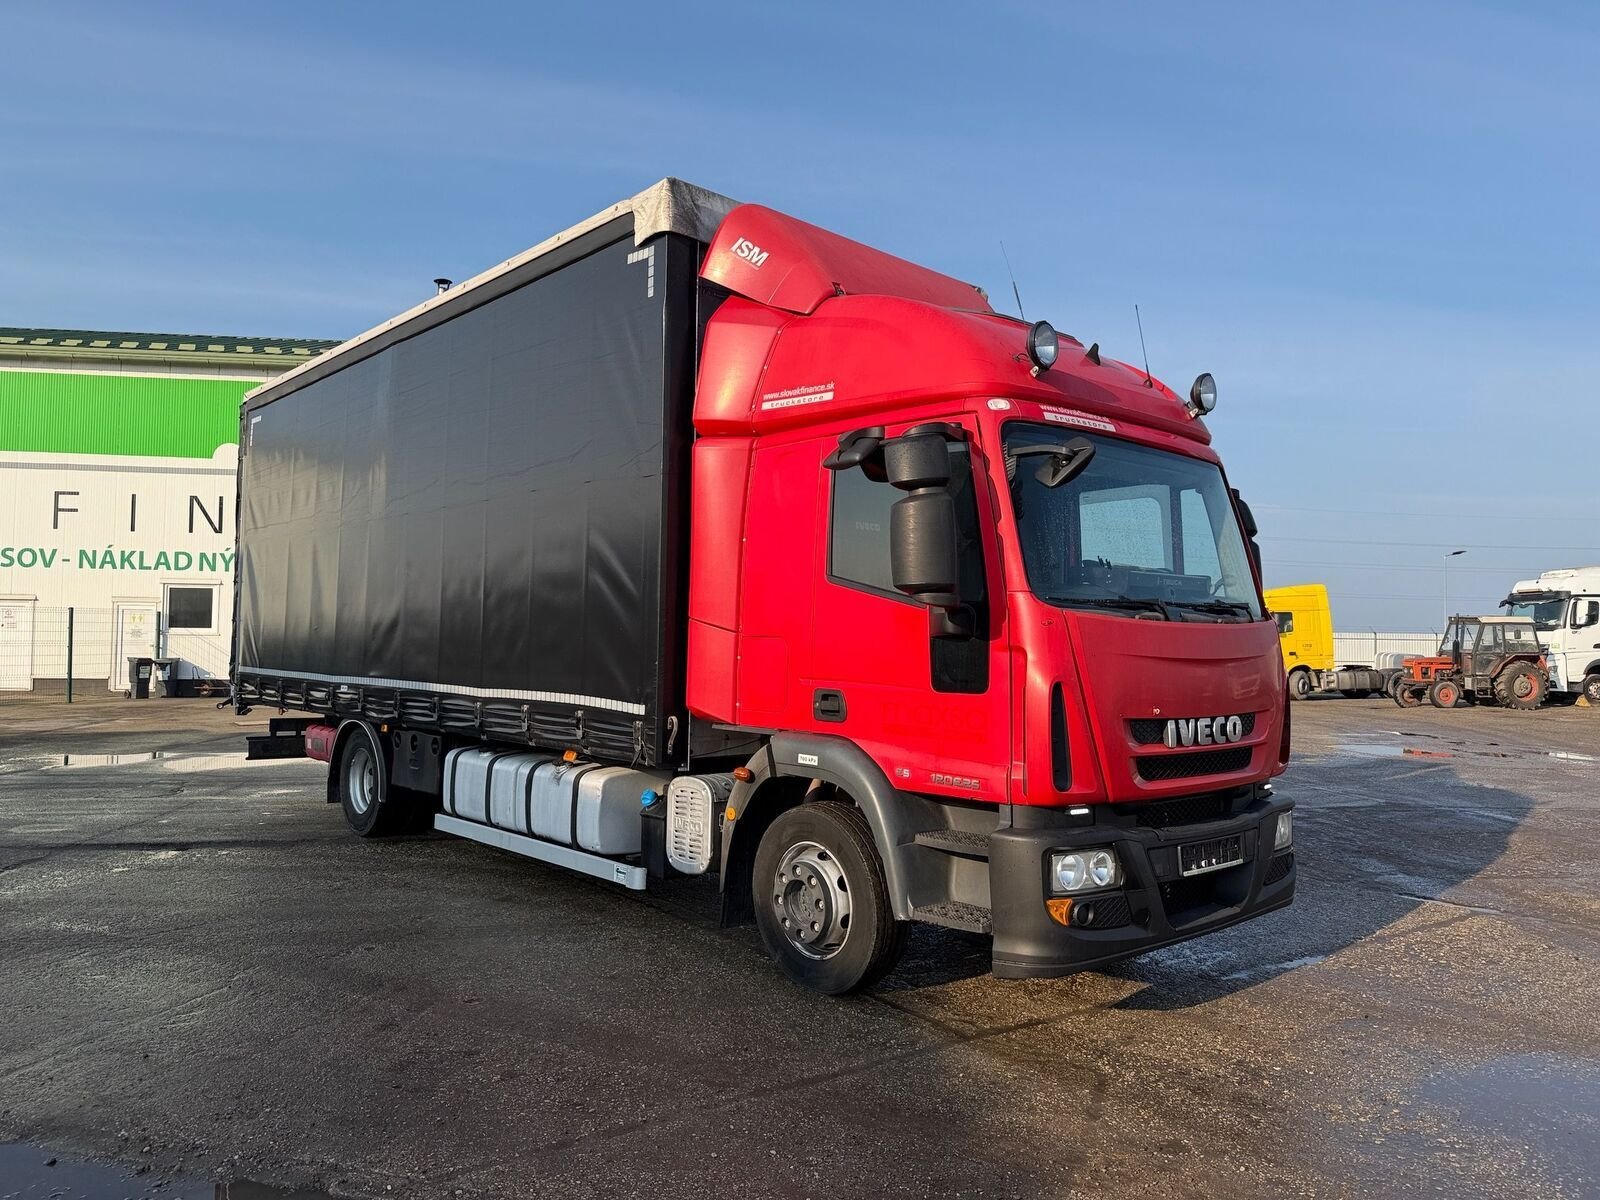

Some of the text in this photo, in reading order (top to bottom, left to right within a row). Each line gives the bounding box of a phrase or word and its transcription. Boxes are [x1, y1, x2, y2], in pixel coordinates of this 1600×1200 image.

[731, 237, 770, 267] ISM
[763, 381, 835, 401] www.slovakfinance.sk
[770, 395, 824, 408] truckstore
[1054, 415, 1108, 430] truckstore
[1163, 715, 1243, 748] IVECO
[674, 817, 703, 834] IVECO
